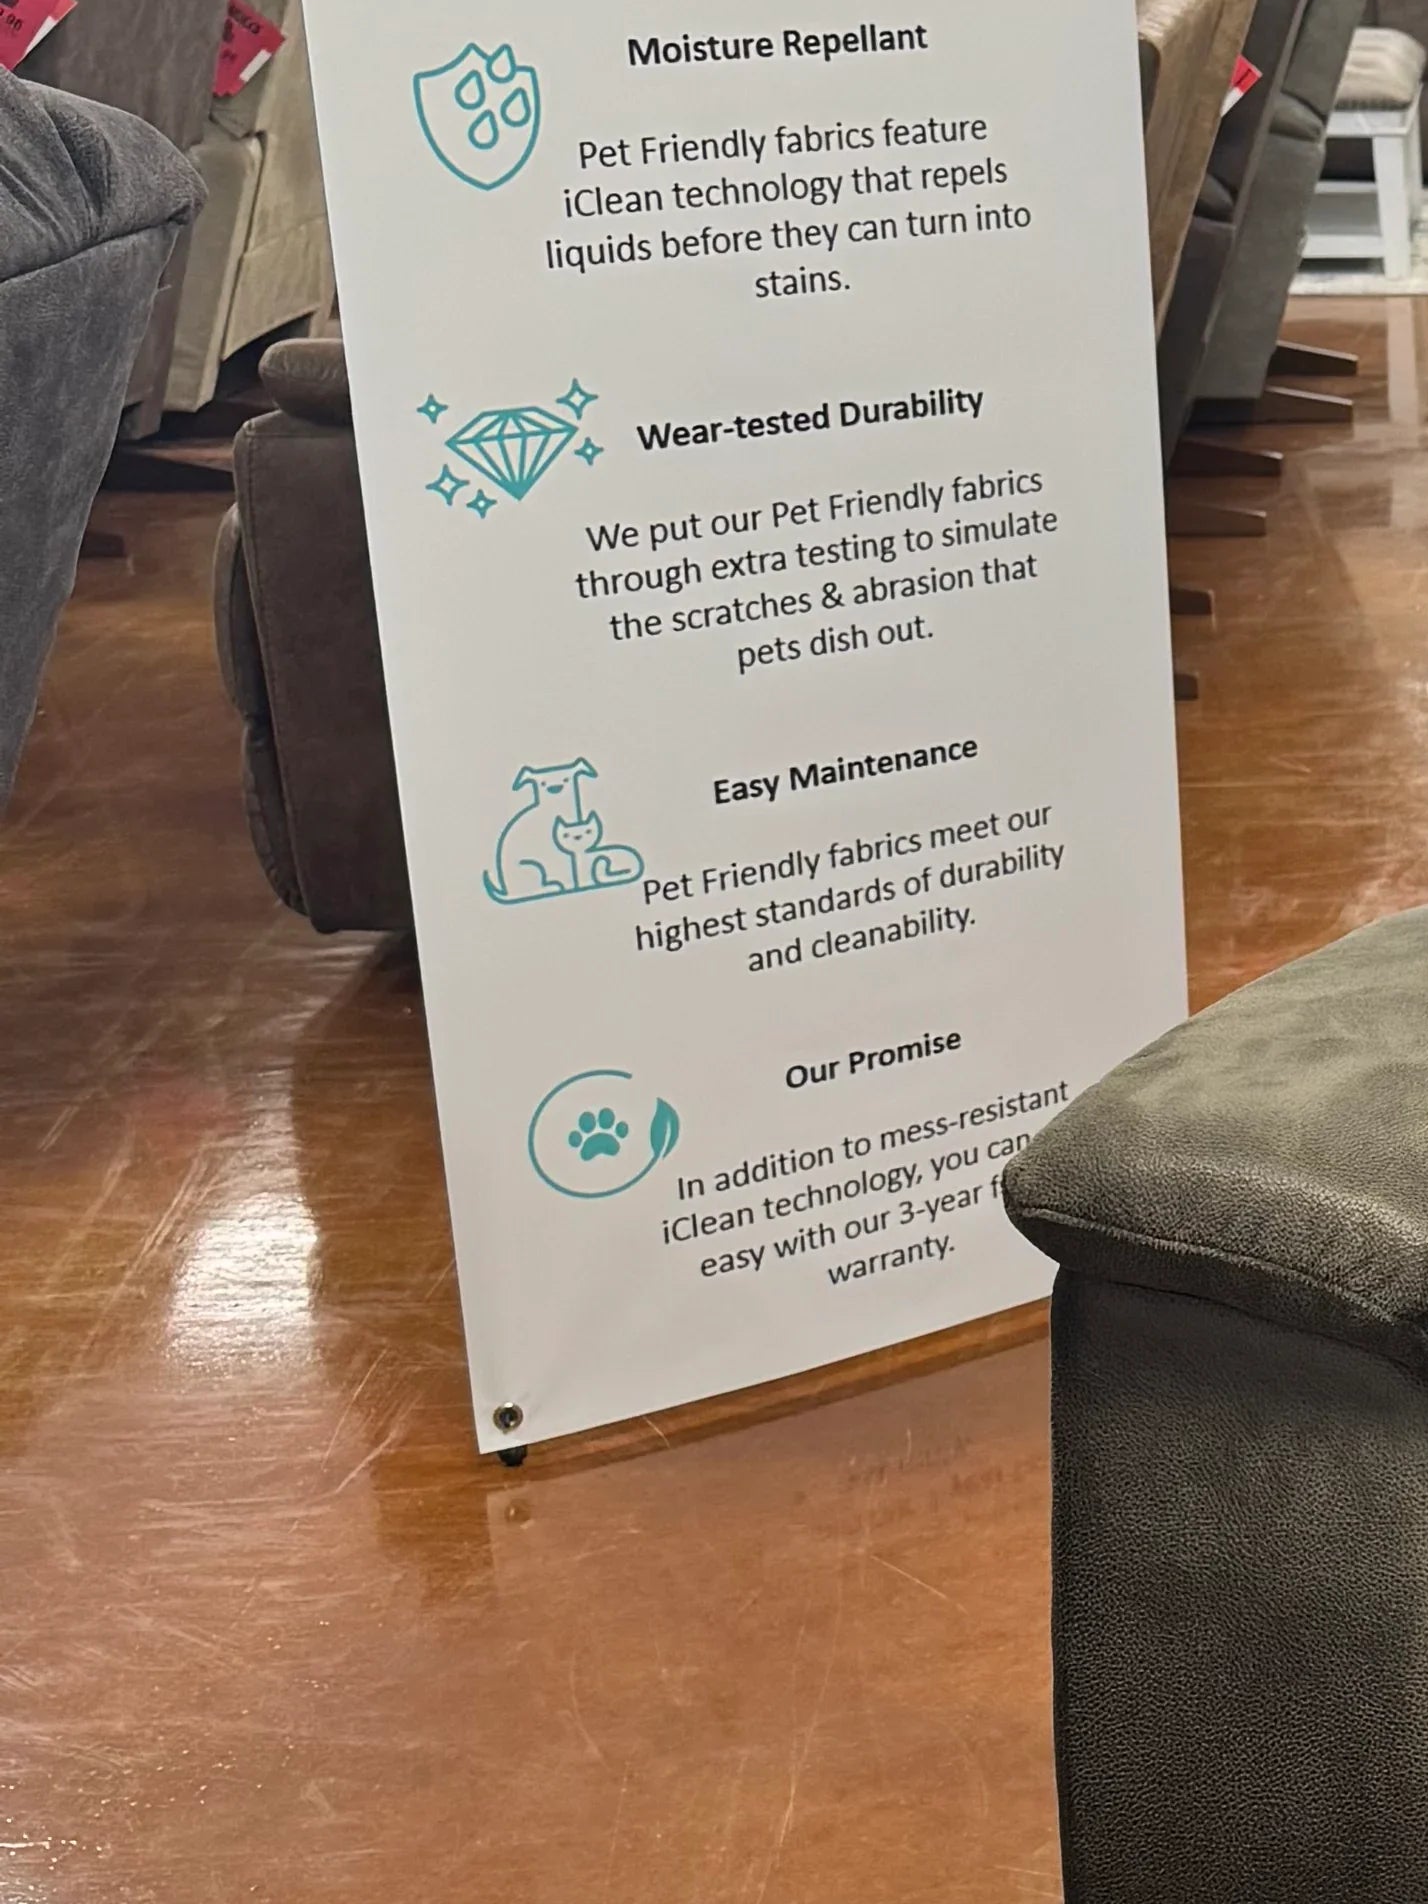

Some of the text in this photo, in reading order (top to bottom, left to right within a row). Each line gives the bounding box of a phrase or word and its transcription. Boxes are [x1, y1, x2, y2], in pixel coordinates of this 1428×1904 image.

[627, 23, 929, 66] Moisture Repellant
[578, 117, 988, 170] Pet Friendly fabrics feature
[563, 156, 1008, 218] iClean technology that repels
[545, 203, 1032, 275] liquids before they can turn into
[755, 265, 851, 299] stains.
[636, 387, 984, 451] Wear-tested Durability
[585, 469, 1043, 552] We put our Pet Friendly fabrics
[575, 510, 1058, 599] through extra testing to simulate
[608, 554, 1038, 641] the scratches & abrasion that
[737, 615, 934, 676] pets dish out.
[713, 739, 978, 805] Easy Maintenance
[643, 805, 1052, 905] Pet Friendly fabrics meet our
[635, 843, 1065, 953] highest standards of durability
[748, 906, 976, 972] and cleanability.
[785, 1032, 962, 1089] Our Promise
[677, 1080, 1069, 1201] In addition to mess-resistant
[662, 1133, 1030, 1245] iClean technology, you can
[700, 1245, 766, 1277] easy
[773, 1222, 836, 1259] with
[844, 1210, 891, 1240] our
[898, 1185, 983, 1225] 3-year
[827, 1235, 955, 1285] warranty.
